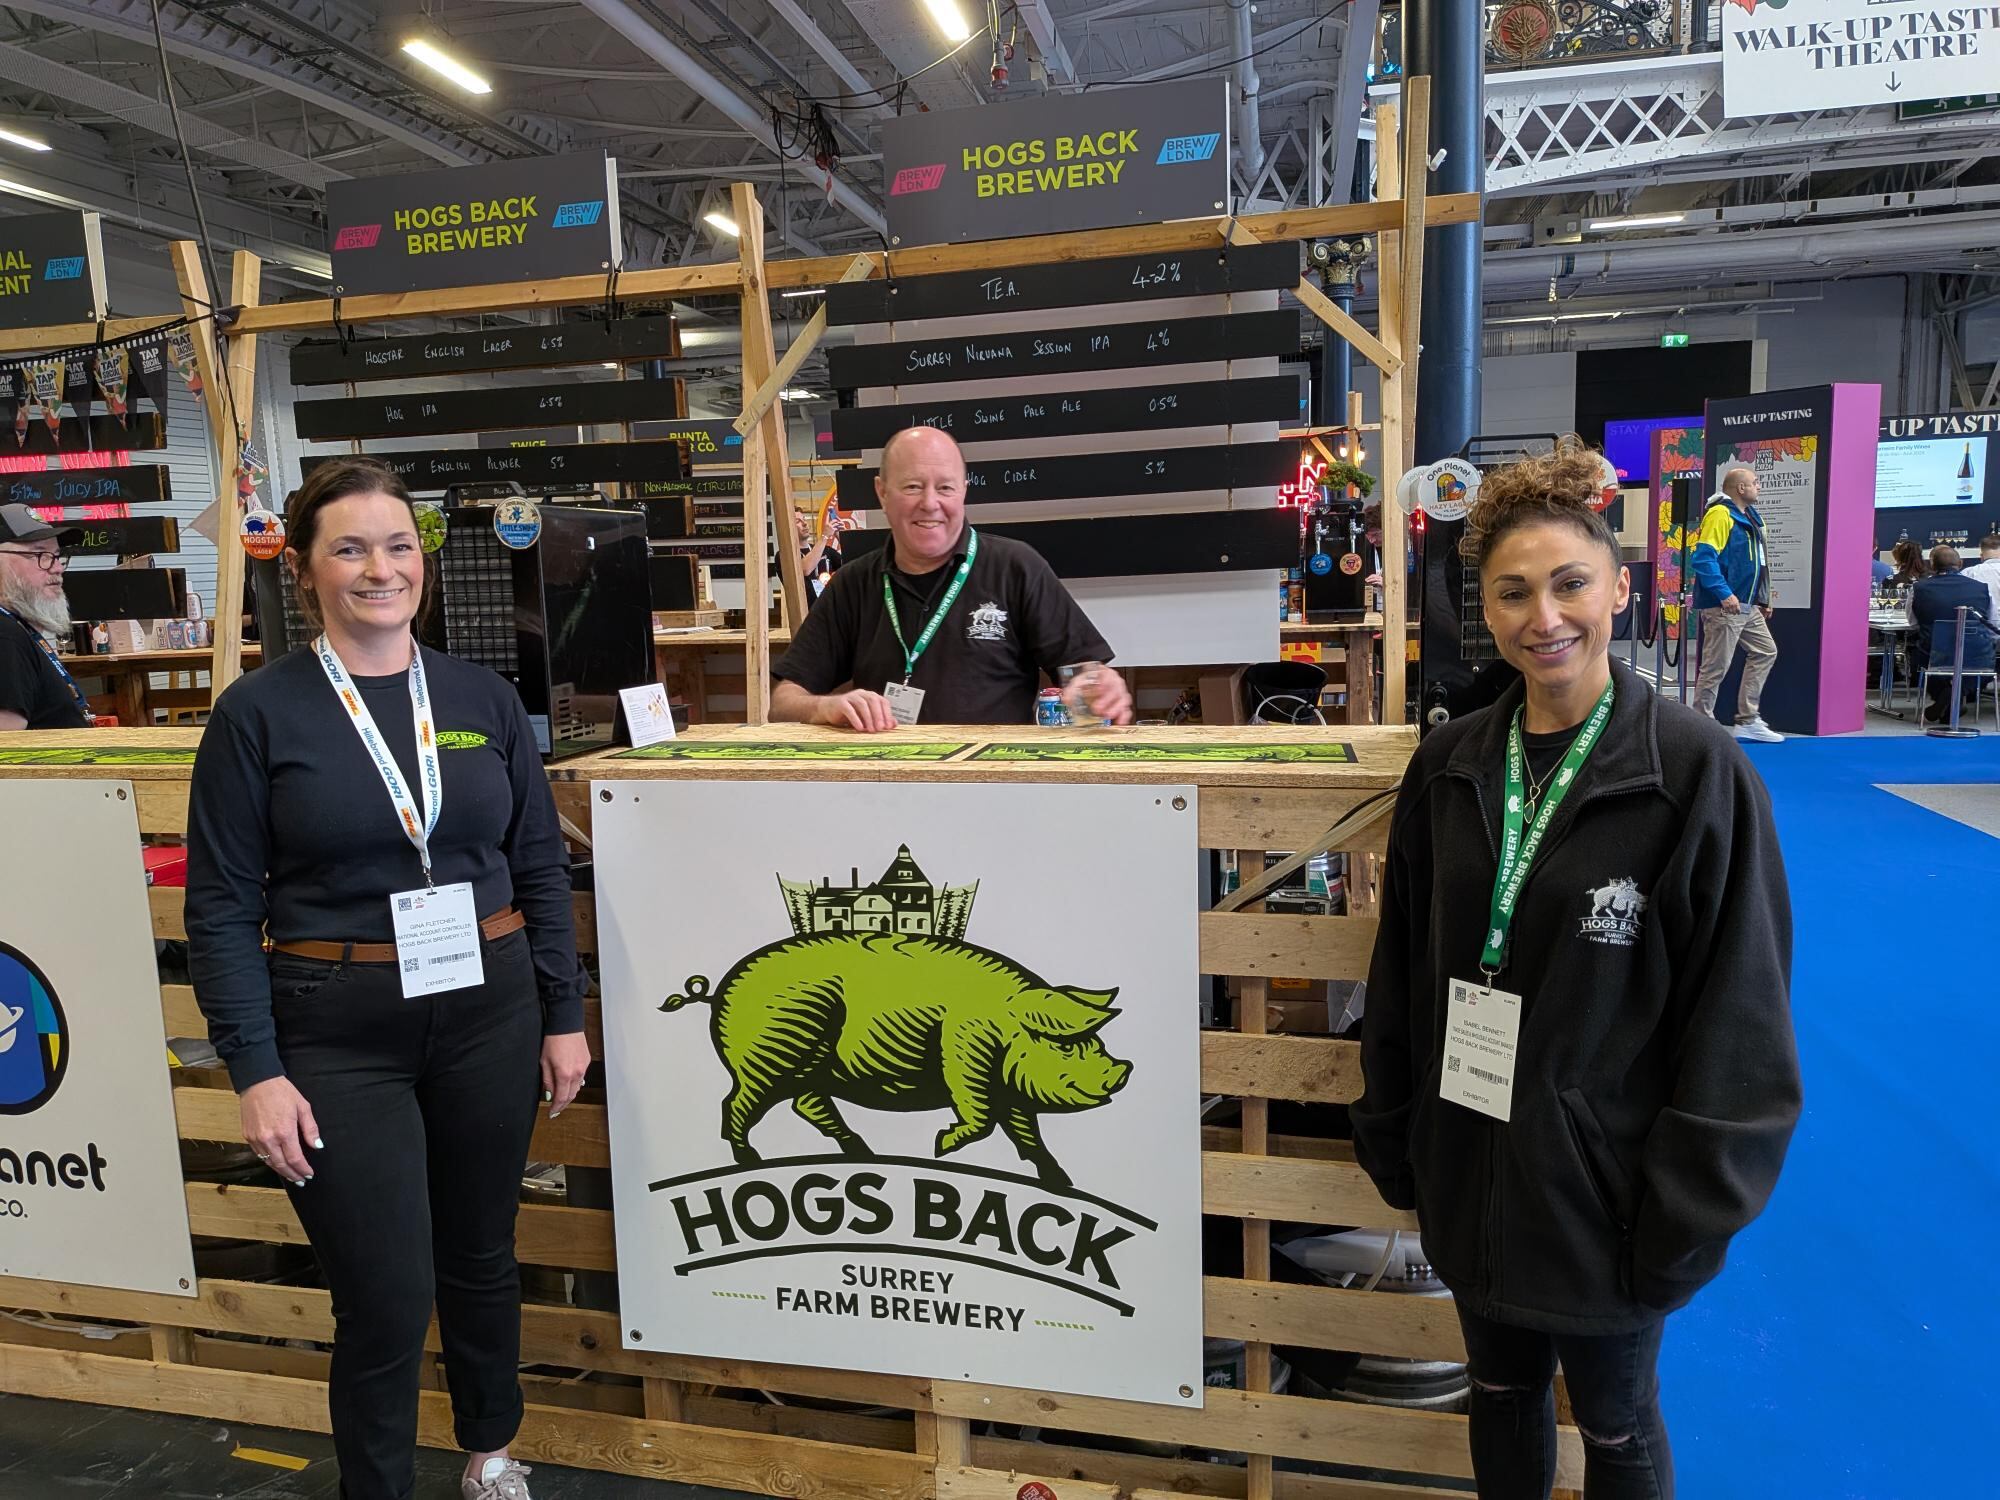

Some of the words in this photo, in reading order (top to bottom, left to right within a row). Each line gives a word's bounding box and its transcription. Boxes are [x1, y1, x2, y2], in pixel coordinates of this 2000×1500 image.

[1733, 16, 1892, 53] WALK-UP
[1807, 33, 1978, 70] THEATRE
[963, 140, 1045, 170] HOGS
[1056, 129, 1138, 161] BACK
[1167, 137, 1204, 151] BREW
[1167, 149, 1195, 161] LDN
[899, 168, 933, 182] BREW
[977, 160, 1125, 198] BREWERY
[899, 180, 924, 192] LDN
[394, 205, 463, 231] HOGS
[470, 196, 538, 223] BACK
[560, 204, 592, 216] BREW
[560, 214, 584, 225] LDN
[341, 228, 370, 239] BREW
[342, 237, 364, 247] LDN
[407, 223, 528, 256] BREWERY
[50, 260, 75, 269] BREW
[51, 269, 70, 278] LDN
[139, 348, 159, 360] TAP
[365, 349, 405, 365] HOGSTAR
[424, 344, 465, 359] ENGLISH
[483, 339, 513, 353] LAGER
[906, 351, 951, 370] SURREY
[966, 345, 1013, 363] NIRVANA
[1032, 339, 1072, 356] SESSION
[1091, 335, 1110, 349] IPA
[1147, 328, 1170, 350] 4%
[101, 359, 120, 371] TAP
[142, 359, 160, 369] SOCIAL
[36, 373, 53, 384] TAP
[102, 369, 121, 378] SOCIAL
[38, 382, 57, 392] SOCIAL
[385, 406, 404, 422] HOG
[422, 403, 438, 417] IPA
[974, 409, 1005, 424] SWINE
[1024, 404, 1045, 418] PALE
[1061, 400, 1082, 413] ALE
[1722, 413, 1766, 427] WALK-UP
[1767, 408, 1812, 422] TASTING
[697, 442, 719, 452] CO.
[430, 461, 471, 474] ENGLISH
[487, 456, 521, 470] PILSNER
[1427, 466, 1443, 482] One
[1444, 462, 1472, 478] Planet
[967, 471, 986, 486] HOG
[1004, 468, 1037, 484] CIDER
[1760, 478, 1810, 489] TIMETABLE
[1765, 471, 1802, 481] TASTING
[53, 479, 91, 500] JUICY
[94, 478, 121, 498] IPA
[696, 480, 726, 493] CITRUS
[1428, 502, 1448, 511] HAZY
[82, 530, 109, 547] ALE
[243, 536, 282, 544] HOGSTAR
[322, 653, 344, 683] GORI
[413, 669, 425, 708] Hillebrand
[1575, 702, 1611, 755] BREWERY
[460, 734, 487, 745] BACK
[1509, 729, 1519, 754] BACK
[361, 727, 386, 766] Hillebrand
[382, 766, 404, 800] GORI
[425, 755, 437, 788] GORI
[1510, 755, 1520, 783] HOGS
[1536, 799, 1557, 829] HOGS
[1521, 828, 1545, 860] BACK
[1498, 859, 1529, 914] BREWERY
[425, 917, 456, 927] FLETCHER
[1582, 919, 1618, 930] HOGS
[1620, 921, 1638, 934] BAC
[397, 932, 419, 940] NATIONAL
[442, 923, 472, 933] CONTROLLER
[1589, 935, 1608, 944] FARM
[1604, 932, 1627, 940] SURREY
[398, 940, 416, 948] HOGS
[416, 937, 433, 945] BACK
[433, 934, 459, 943] BREWERY
[425, 977, 457, 987] EXHIBITOR
[1464, 1019, 1481, 1031] ISABEL
[1481, 1025, 1506, 1038] BENNETT
[1450, 1035, 1464, 1045] HOGS
[1464, 1039, 1478, 1049] BACK
[1479, 1044, 1503, 1057] BREWERY
[1503, 1052, 1514, 1061] LTD
[1462, 1090, 1490, 1105] EXHIBITOR
[670, 1172, 894, 1256] HOGS
[911, 1177, 1138, 1291] BACK
[840, 1263, 955, 1294] SURREY
[775, 1286, 861, 1318] FARM
[870, 1291, 1026, 1333] BREWERY
